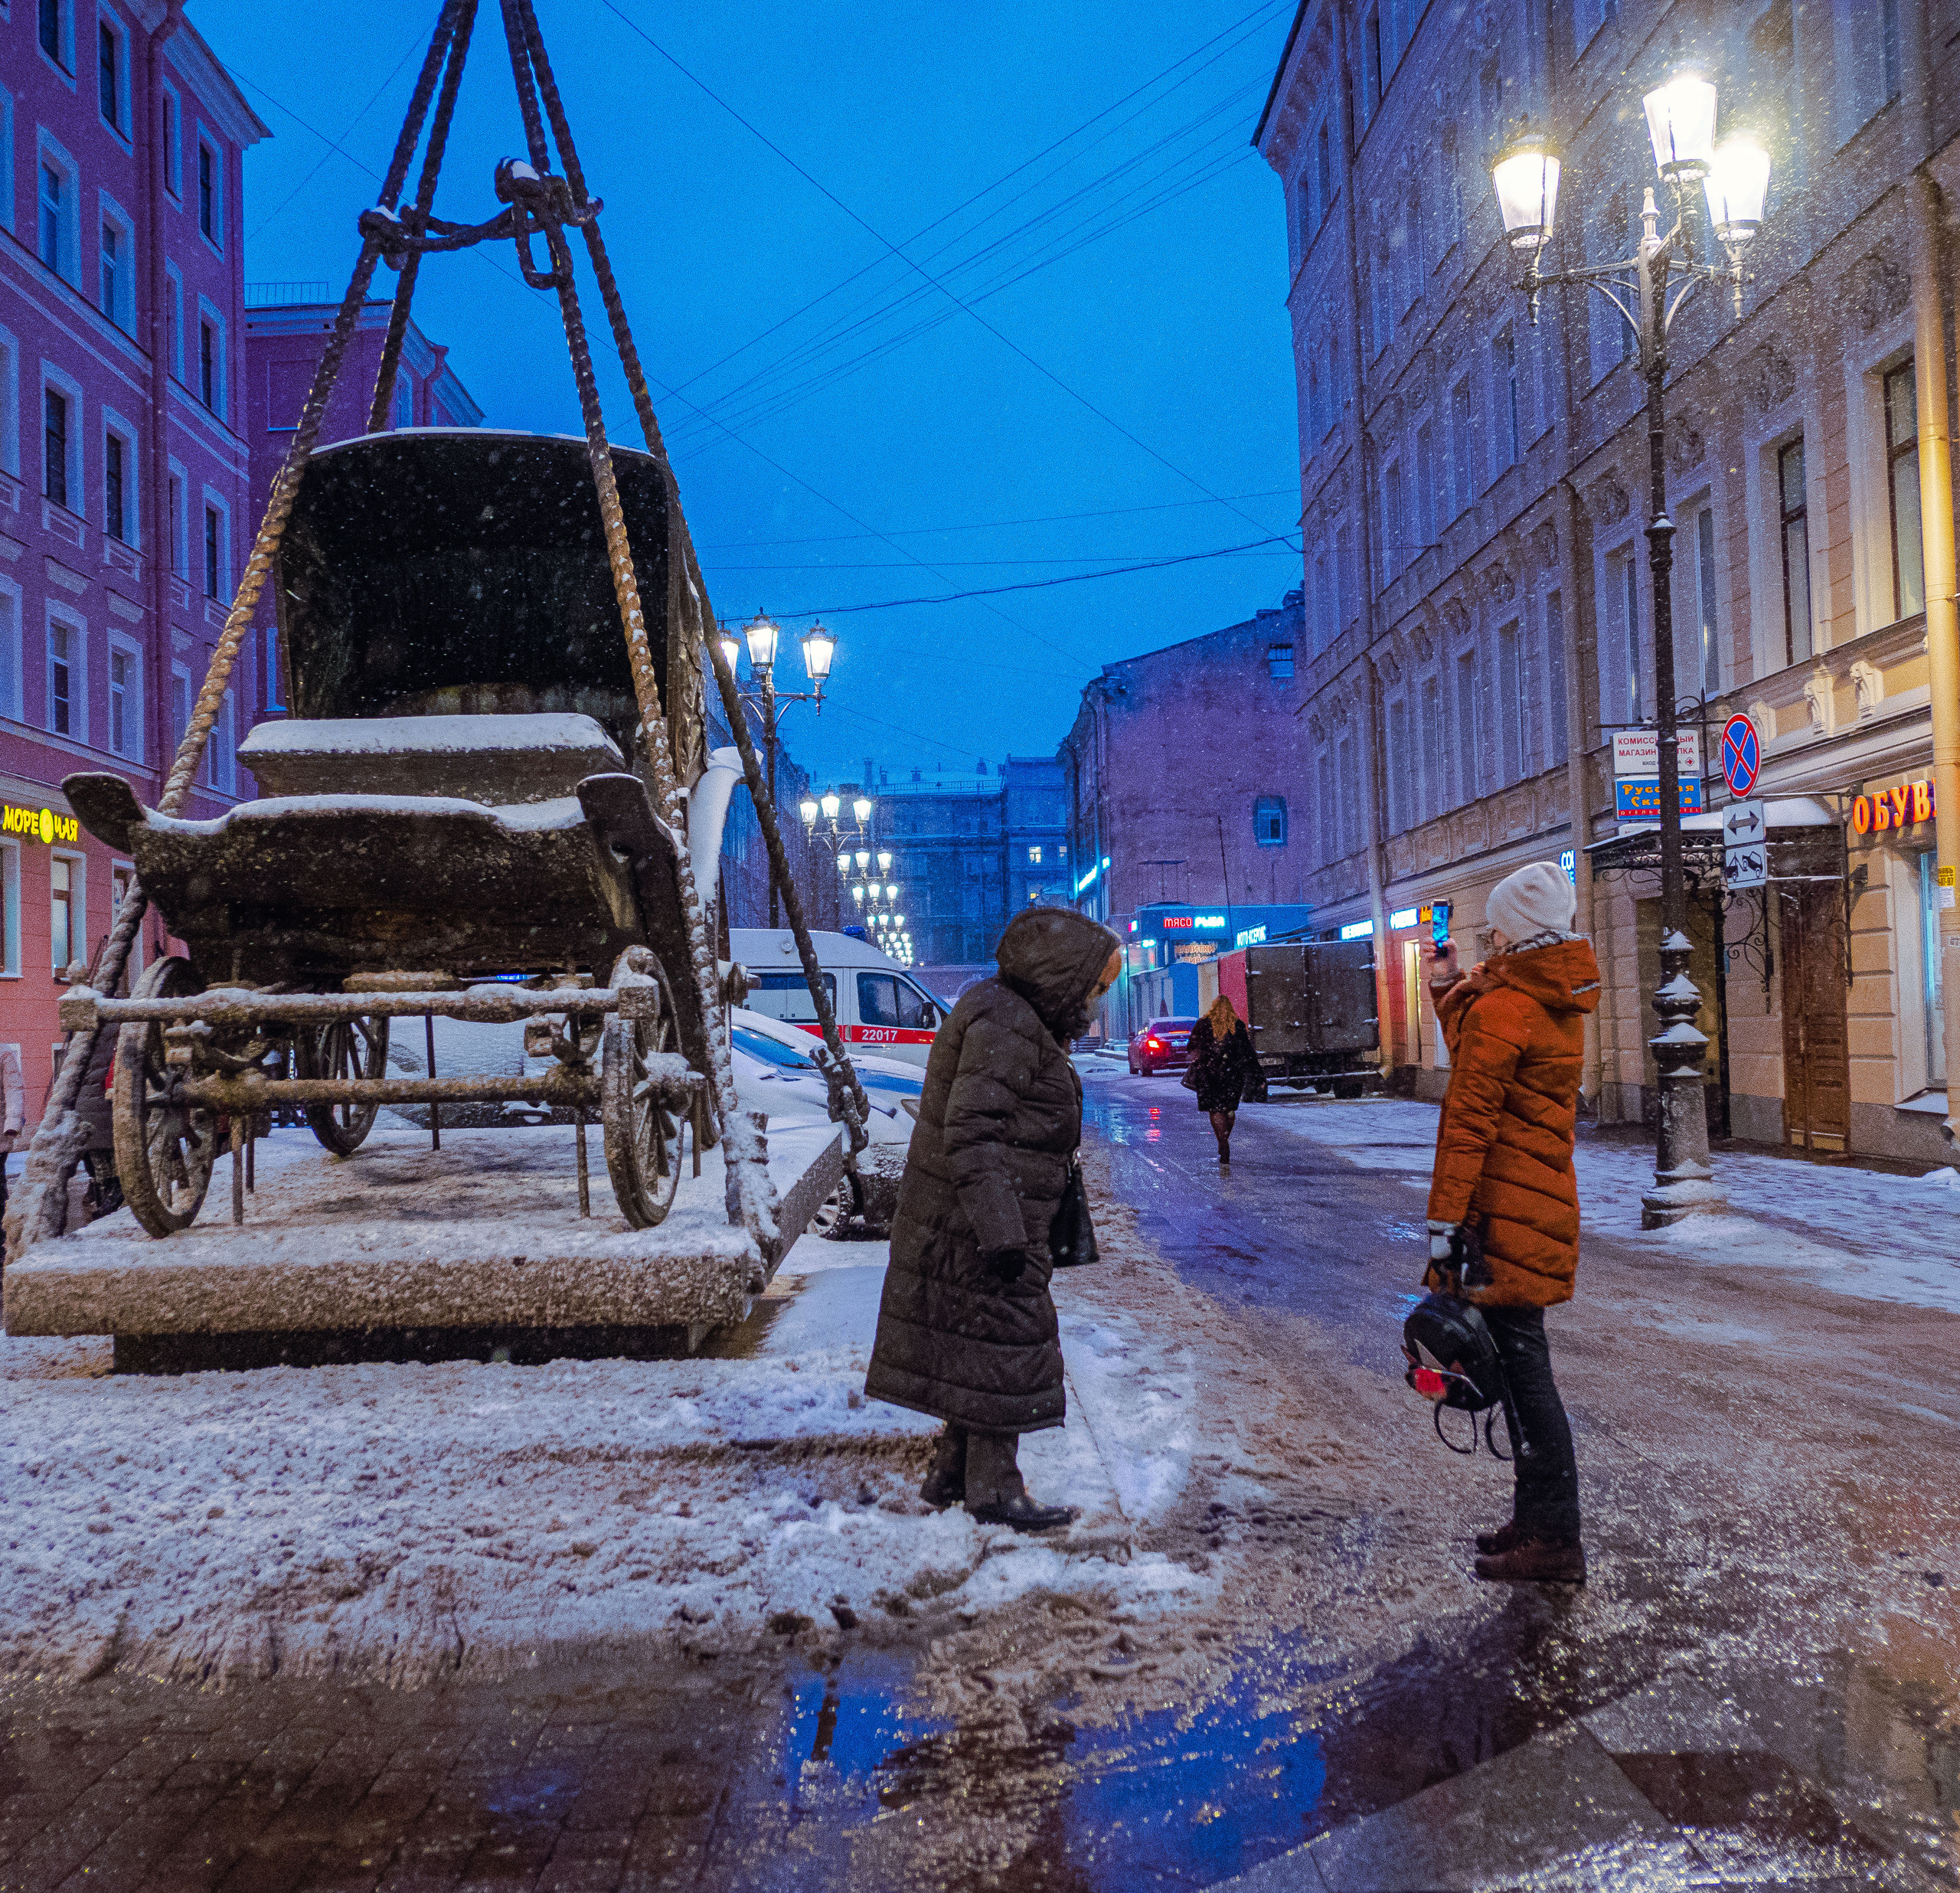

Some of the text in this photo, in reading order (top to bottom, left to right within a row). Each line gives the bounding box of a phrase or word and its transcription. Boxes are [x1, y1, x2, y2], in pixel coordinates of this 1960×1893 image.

[1622, 784, 1694, 795] Руссая
[1631, 796, 1692, 807] Скаа
[2, 805, 40, 835] МОРЕ
[1164, 917, 1193, 928] МЯСО
[1174, 944, 1214, 953] НАПИТКИ
[862, 1028, 898, 1041] 22017
